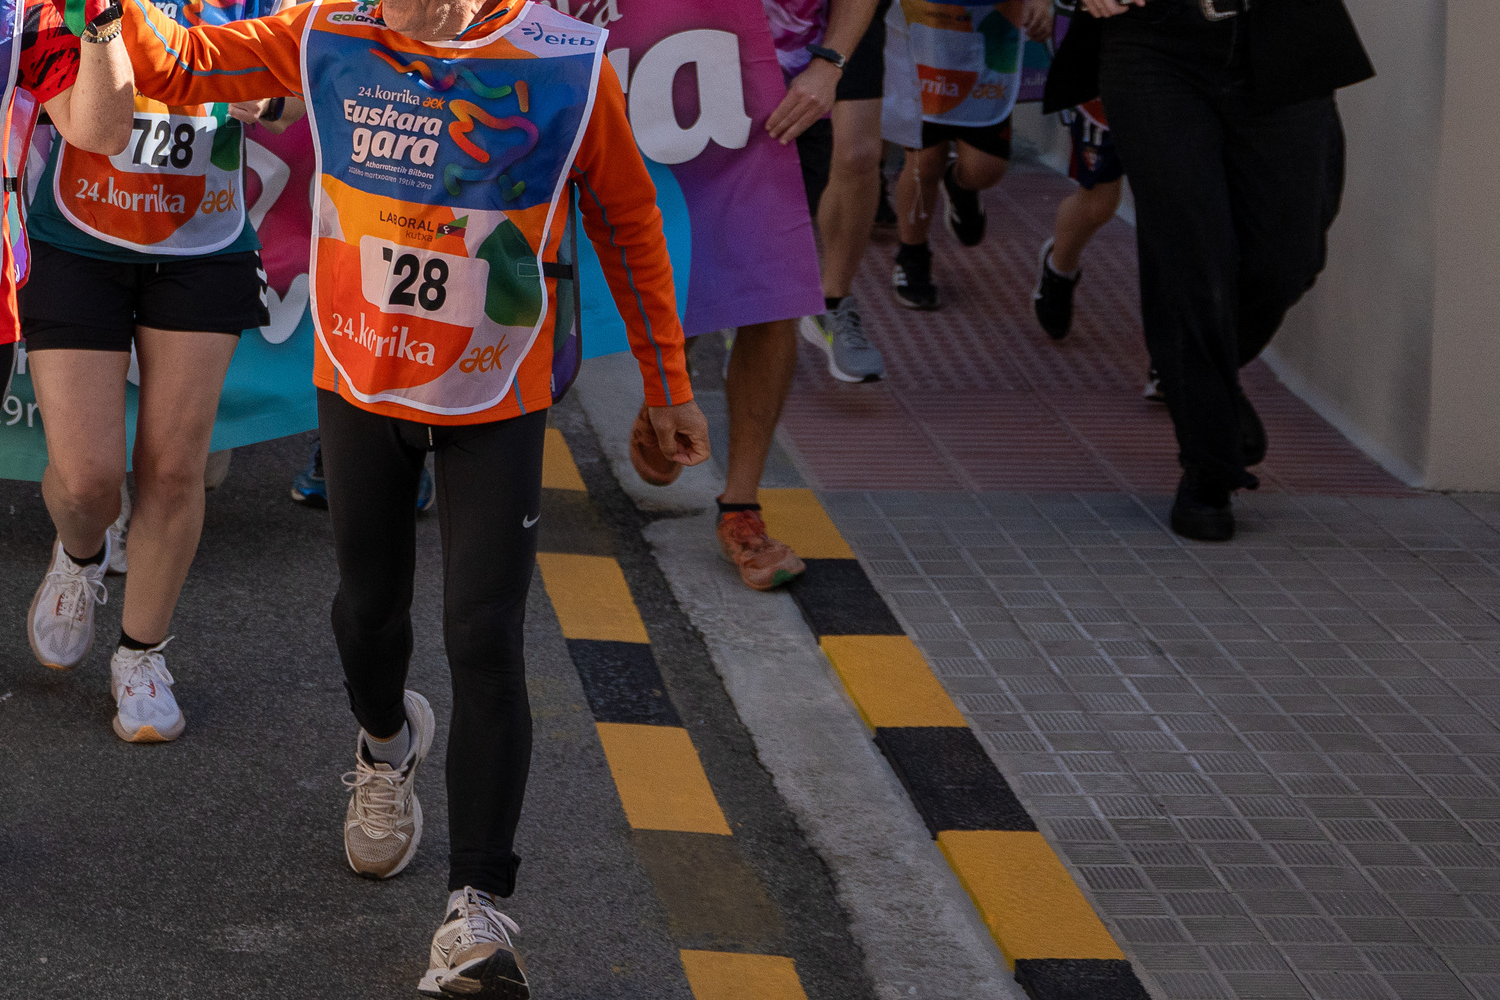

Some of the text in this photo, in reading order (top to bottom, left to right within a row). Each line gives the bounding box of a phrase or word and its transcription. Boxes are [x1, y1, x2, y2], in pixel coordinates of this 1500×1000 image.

[545, 32, 595, 46] eitb
[358, 85, 447, 110] 24.korrika aek
[343, 99, 443, 137] Euskara
[132, 117, 195, 169] 728
[351, 127, 439, 167] gara
[365, 160, 435, 180] Atharratzetik Bilbora
[398, 176, 416, 186] 19tik
[416, 180, 432, 190] 29ra
[75, 176, 239, 216] 24.korrika aek
[405, 231, 433, 242] kutxa
[459, 334, 510, 374] aek
